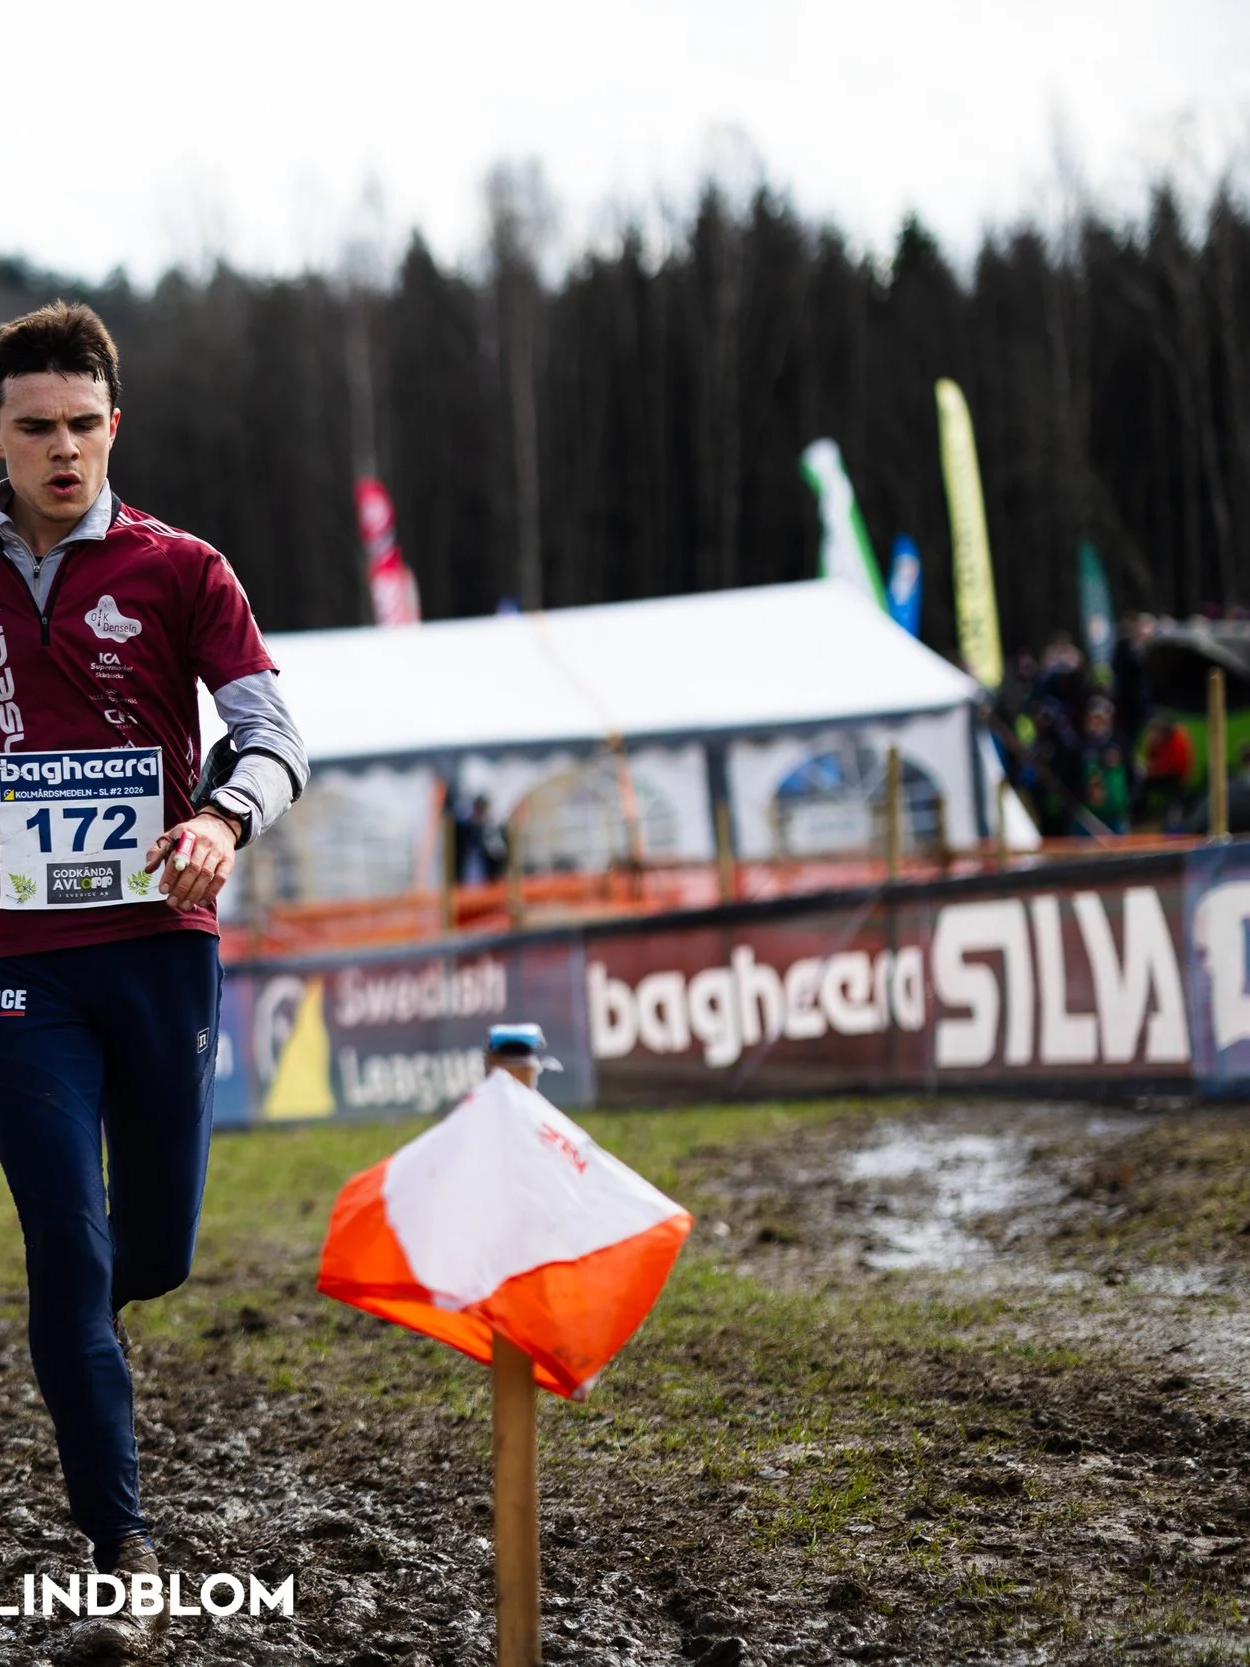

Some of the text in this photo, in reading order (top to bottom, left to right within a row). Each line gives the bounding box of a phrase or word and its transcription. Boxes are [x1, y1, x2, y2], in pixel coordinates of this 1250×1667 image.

[103, 622, 137, 633] Denseln
[98, 652, 121, 665] ICA
[0, 756, 158, 785] bagheera
[15, 788, 92, 799] KOLMÅRDSMEDELN
[99, 788, 109, 796] SL
[110, 787, 122, 795] #2
[123, 786, 144, 795] 2026
[26, 804, 138, 853] 172
[53, 866, 114, 879] GODKÄNDA
[336, 954, 507, 1027] Swedish
[932, 885, 1190, 1069] SILVA
[587, 944, 925, 1068] bagheera
